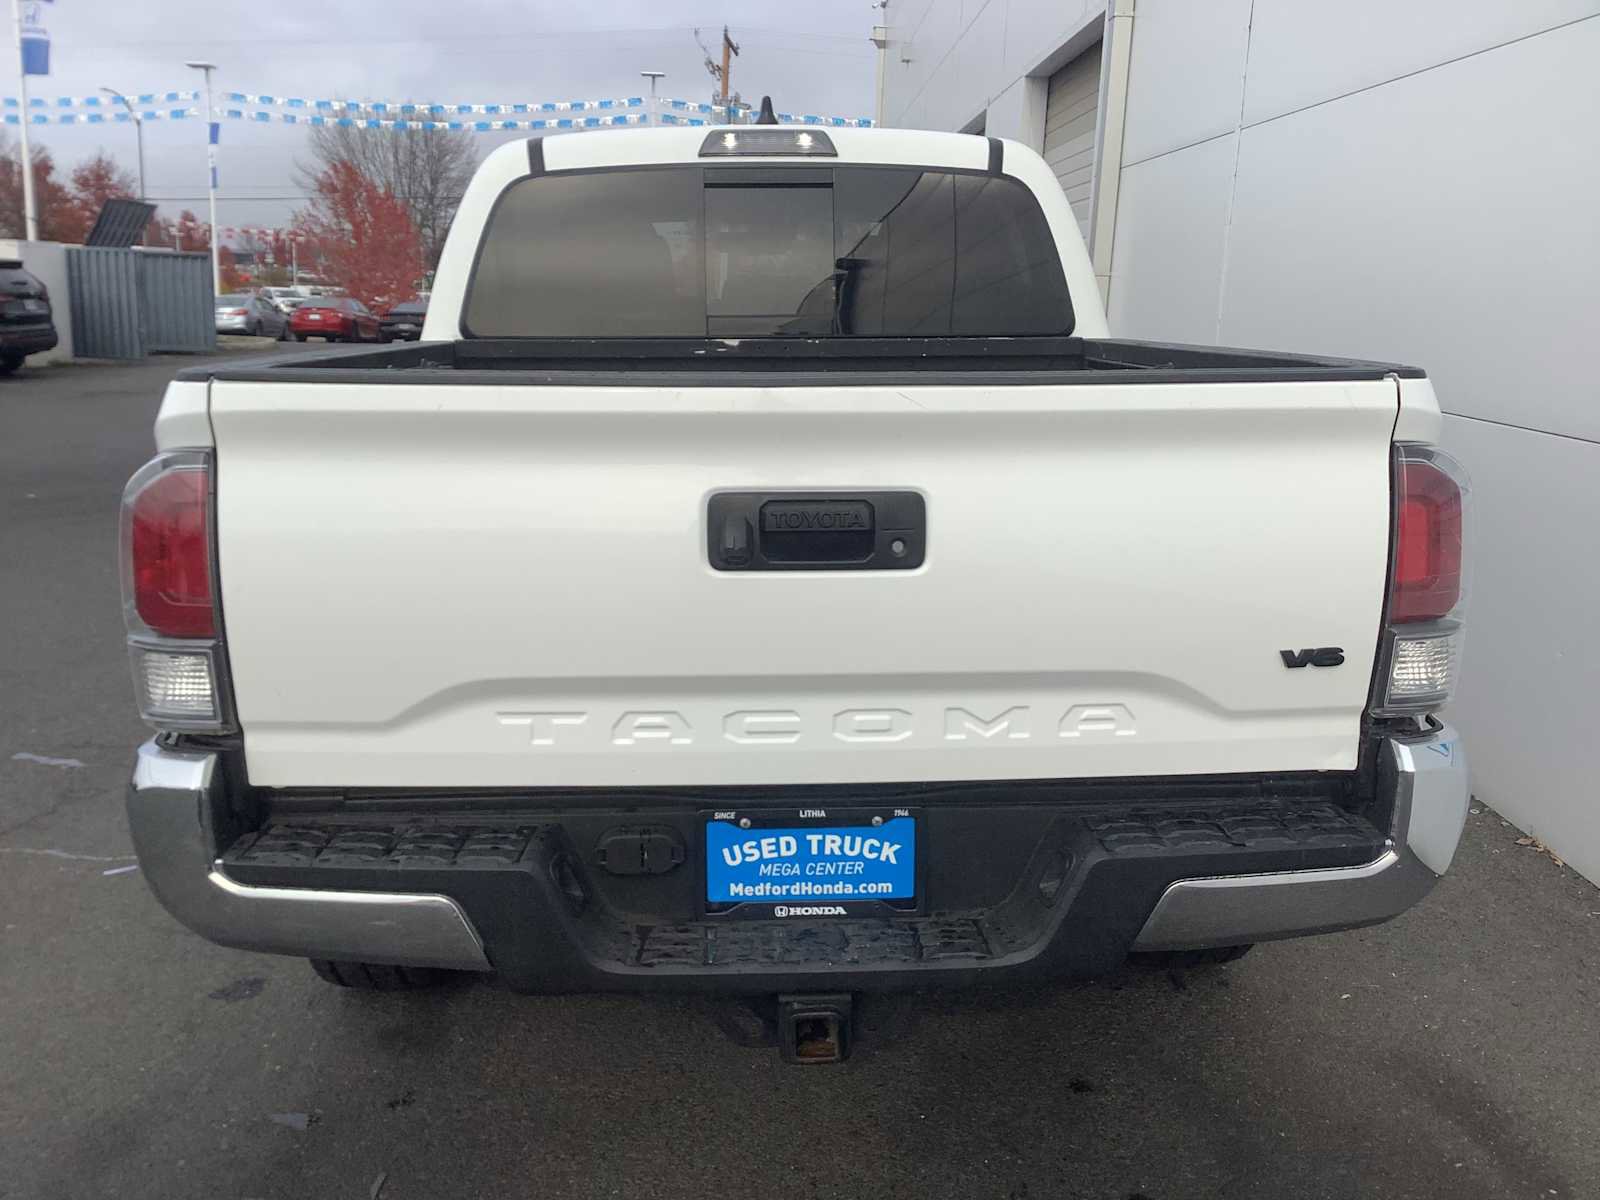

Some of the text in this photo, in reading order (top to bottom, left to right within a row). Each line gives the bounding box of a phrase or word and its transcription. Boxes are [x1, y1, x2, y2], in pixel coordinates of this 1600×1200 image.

[771, 511, 865, 529] TOYOTA
[1280, 647, 1344, 668] V6
[496, 703, 1137, 745] TACOMA
[714, 811, 736, 820] SINCE
[799, 809, 826, 818] LITHIA
[721, 834, 902, 867] USED TRUCK
[759, 861, 864, 877] MEGA CENTER
[729, 881, 893, 897] MedfordHonda.com
[789, 906, 847, 916] HONDA
